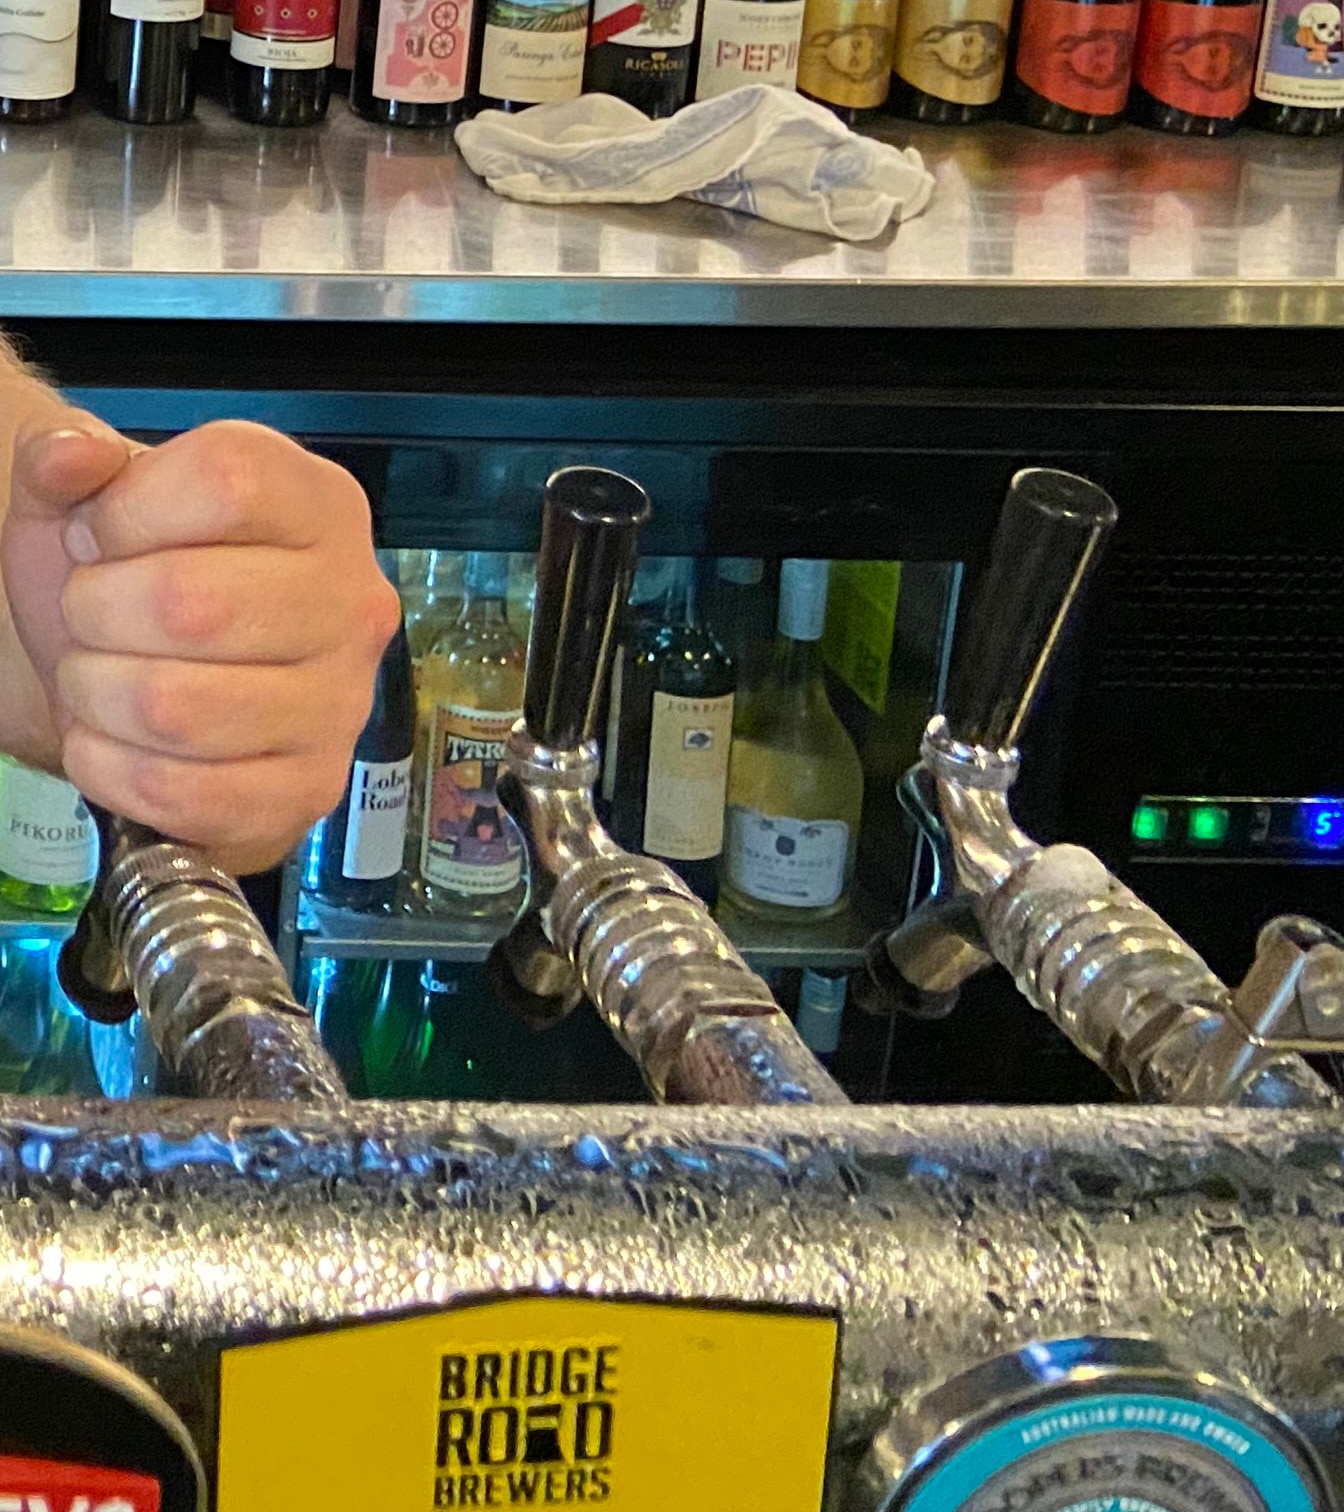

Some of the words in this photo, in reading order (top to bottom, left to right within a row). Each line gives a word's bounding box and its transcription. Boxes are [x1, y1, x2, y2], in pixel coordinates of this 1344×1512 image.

[624, 57, 685, 72] RICASOLI
[440, 1345, 619, 1401] BRIDGE
[1020, 1406, 1118, 1445] AUSTRALIAN
[1122, 1405, 1167, 1425] MADE
[1168, 1411, 1203, 1433] AND
[1202, 1420, 1251, 1456] OWNED
[433, 1467, 612, 1512] BREWERS
